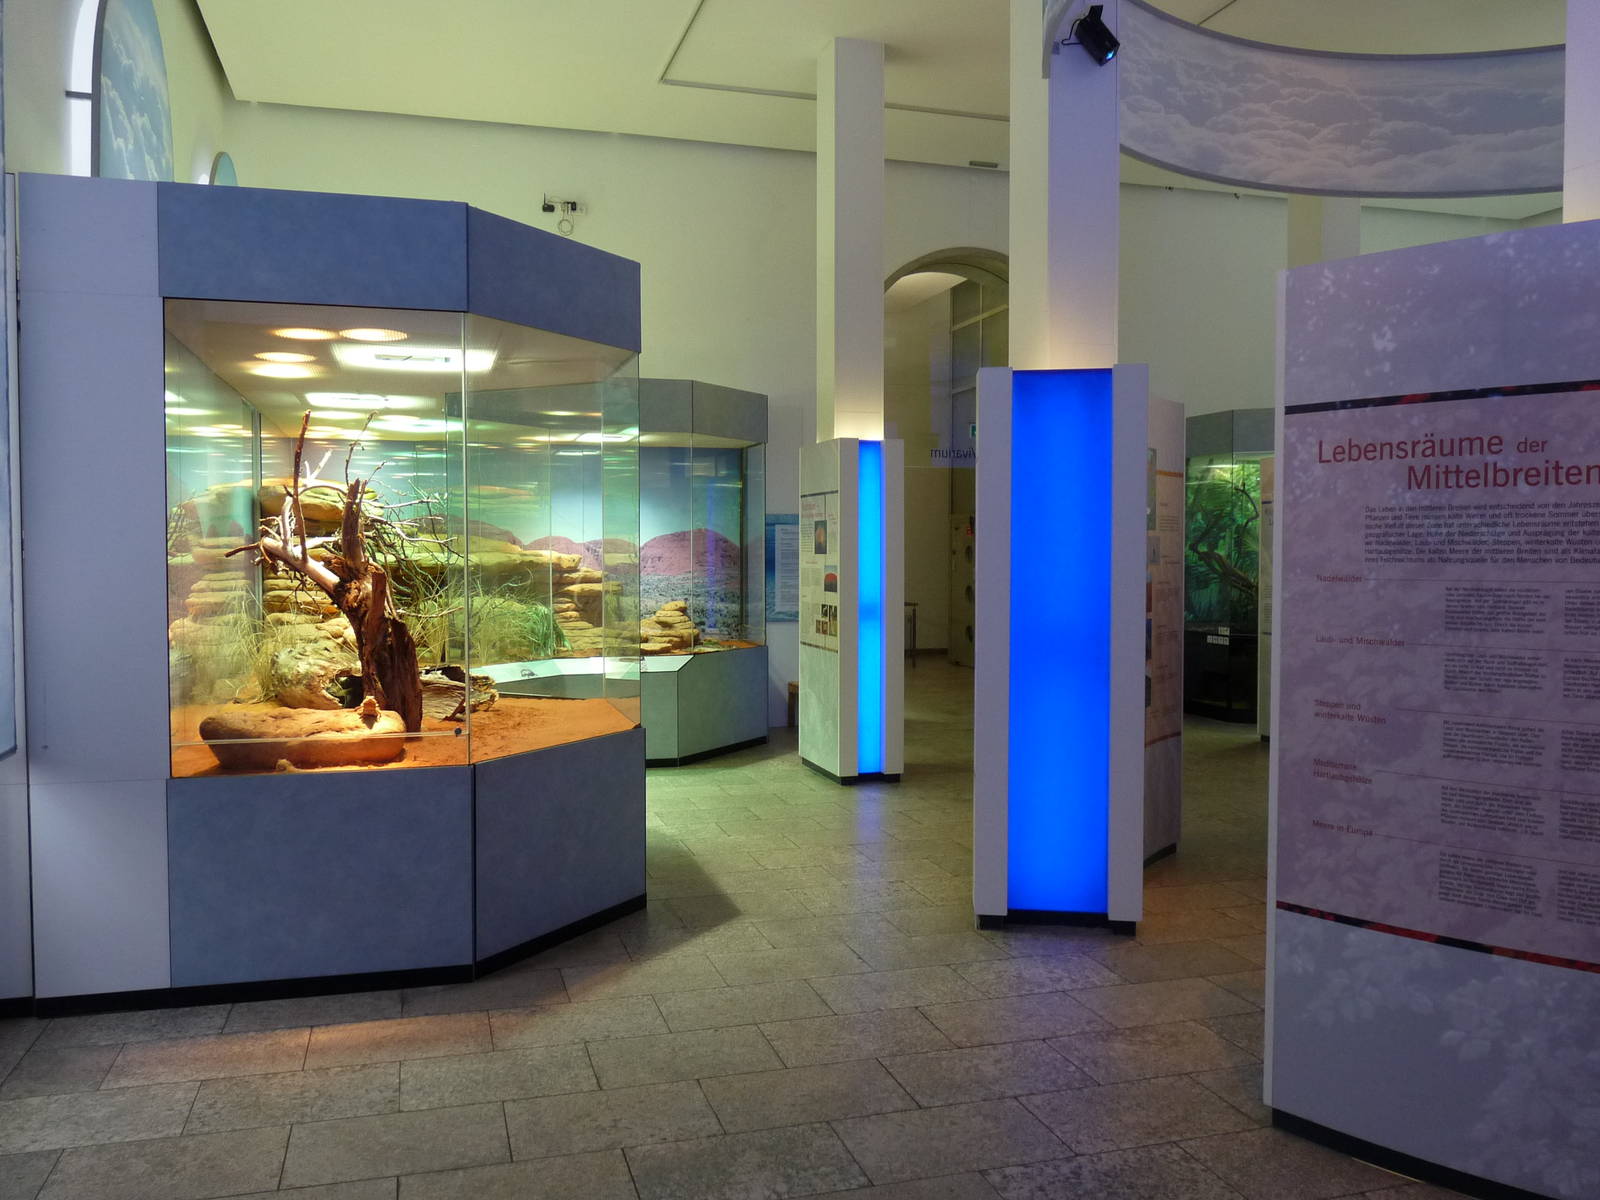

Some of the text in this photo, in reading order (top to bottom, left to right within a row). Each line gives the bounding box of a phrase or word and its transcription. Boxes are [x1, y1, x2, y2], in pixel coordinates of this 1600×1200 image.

[1318, 434, 1548, 463] Lebensräume der
[1406, 459, 1600, 490] Mittelbreiten
